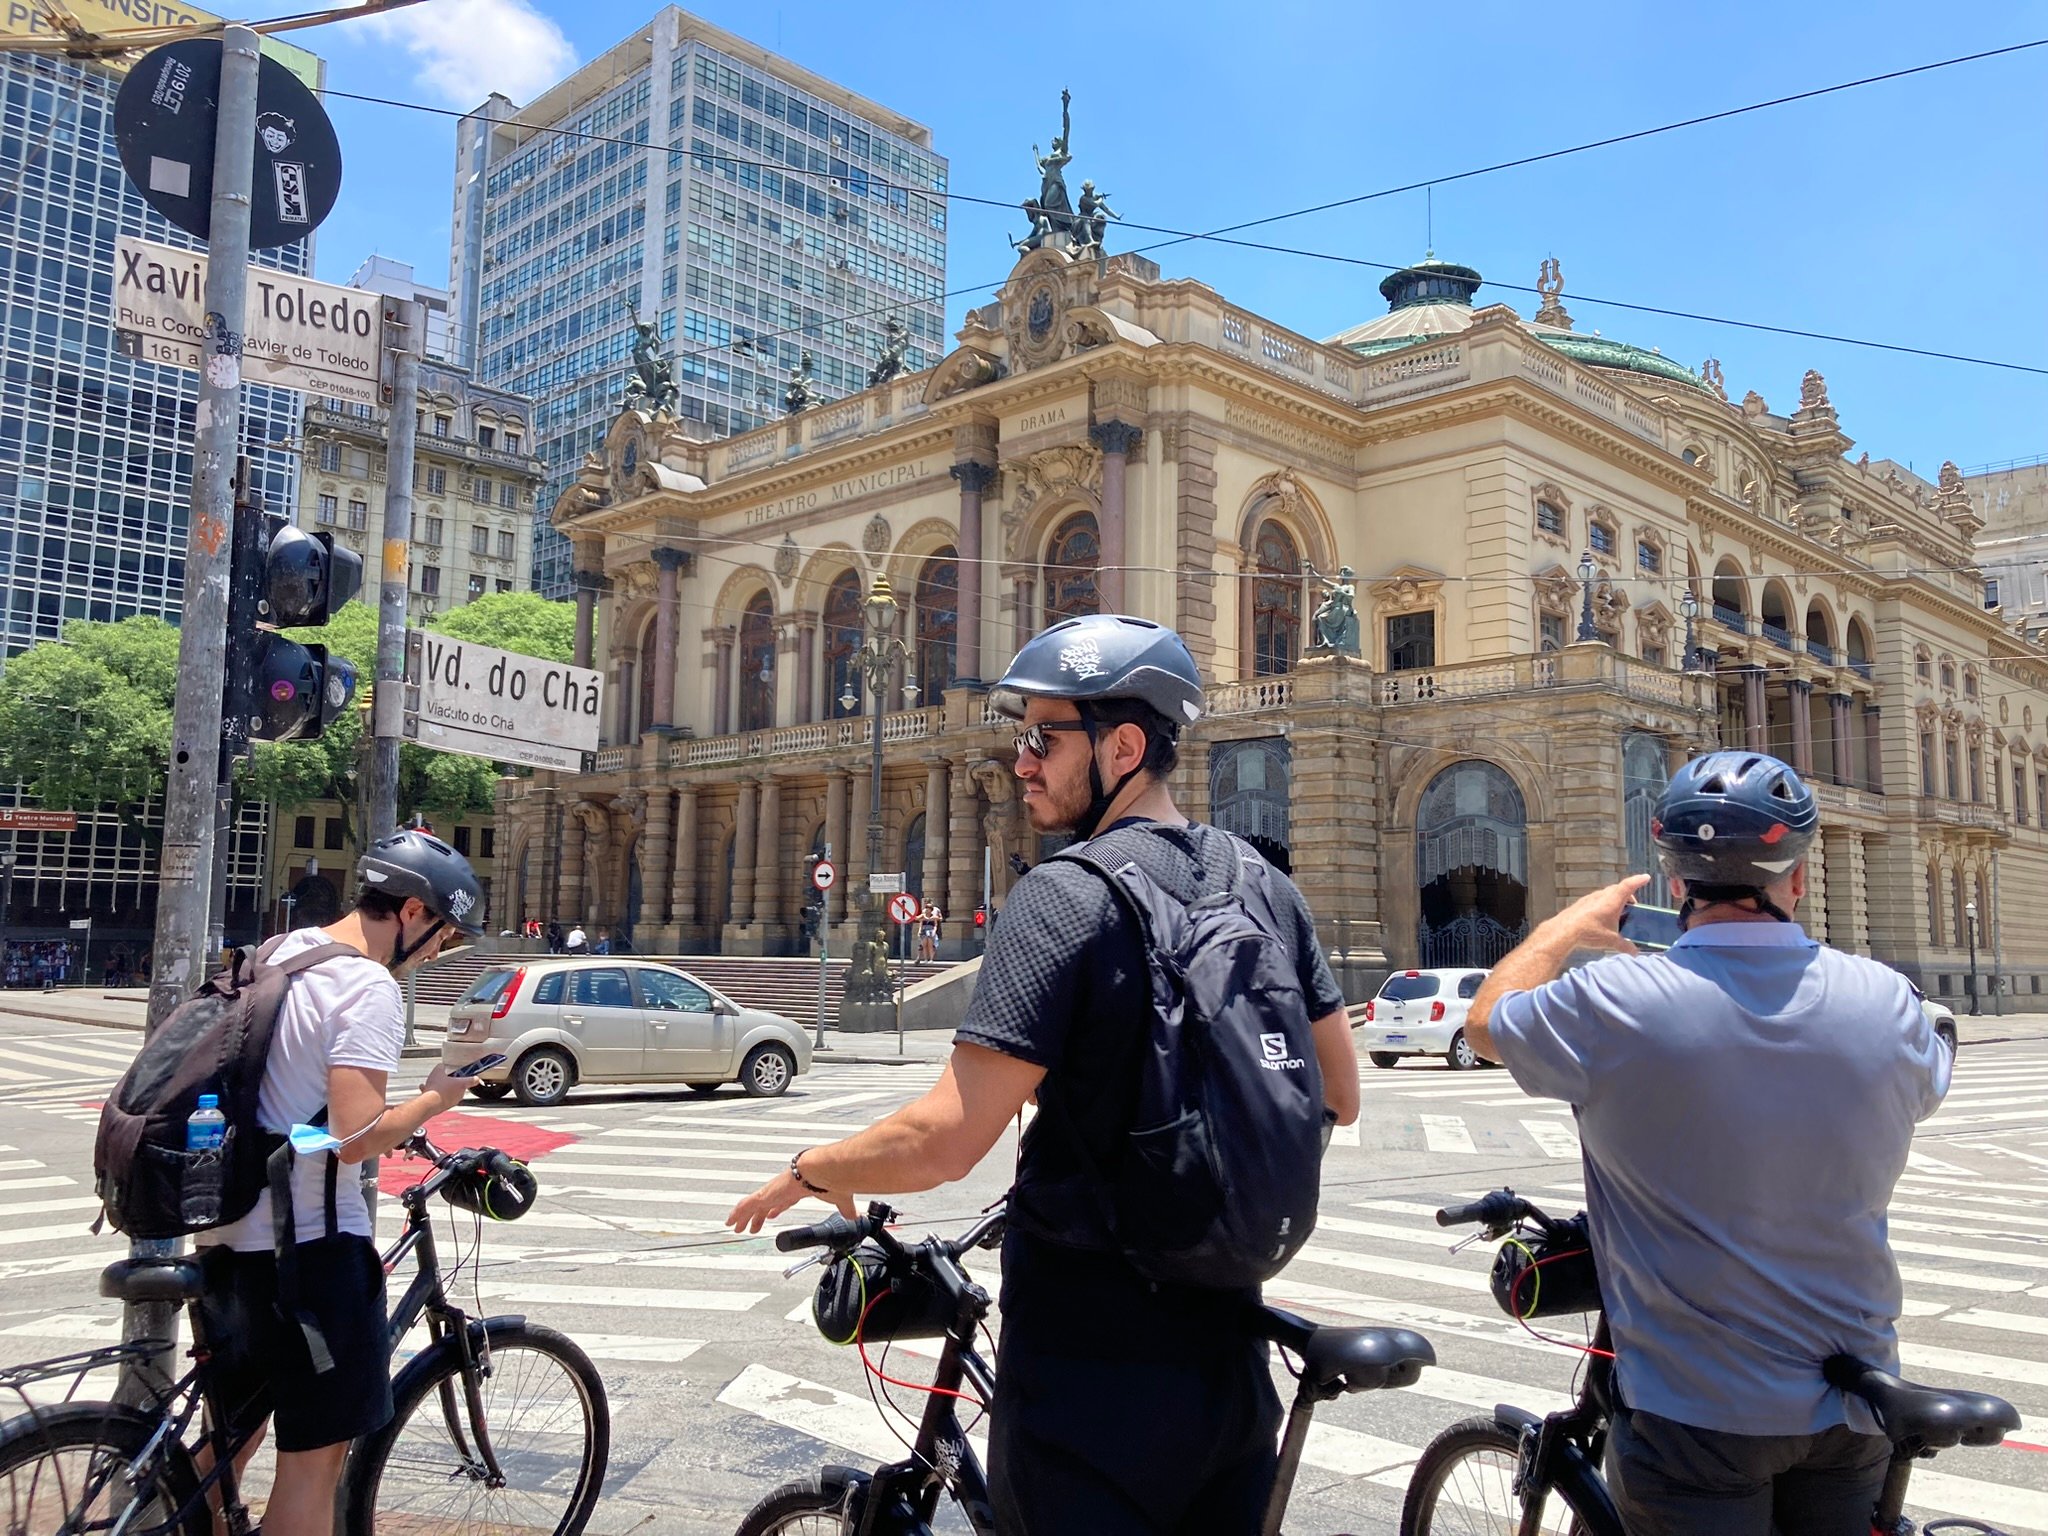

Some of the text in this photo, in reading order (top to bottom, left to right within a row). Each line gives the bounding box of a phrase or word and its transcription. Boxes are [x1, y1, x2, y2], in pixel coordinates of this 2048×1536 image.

[171, 62, 192, 91] 2019
[120, 248, 371, 337] Xavi Toledo
[120, 307, 156, 328] Rua
[292, 345, 312, 359] de
[317, 348, 369, 371] Toledo
[126, 342, 199, 365] 1 161 a
[309, 379, 370, 399] CEP 01048-100
[1020, 407, 1066, 432] DRAMA
[744, 460, 930, 525] THEATRO MVNICIPAL
[427, 640, 599, 716] Vd. do Chá
[427, 700, 515, 730] Viaduto do Chá
[519, 751, 533, 760] CEP
